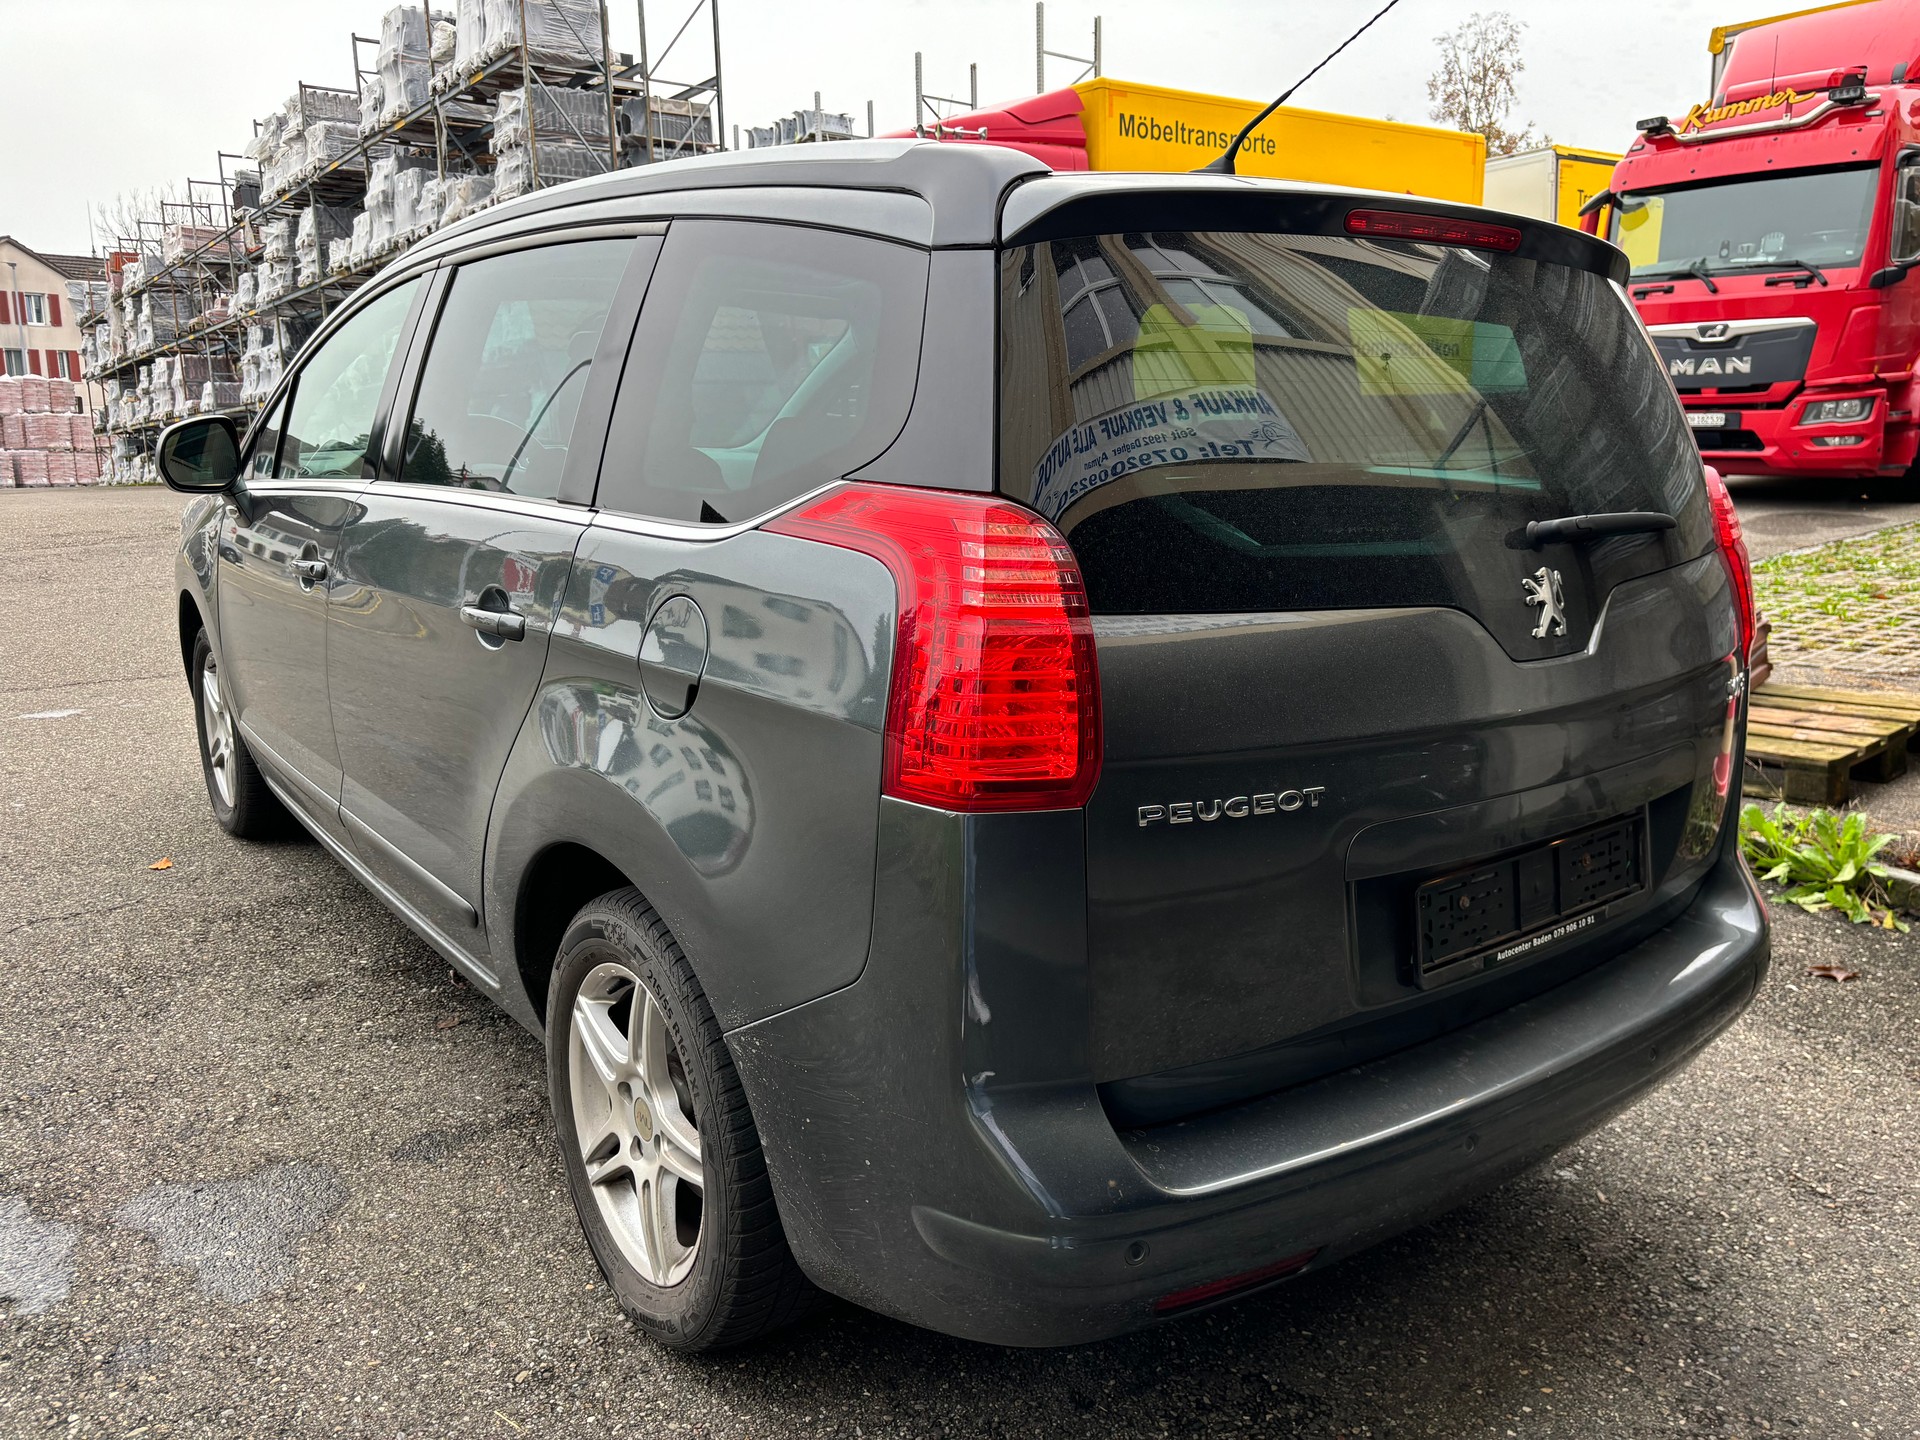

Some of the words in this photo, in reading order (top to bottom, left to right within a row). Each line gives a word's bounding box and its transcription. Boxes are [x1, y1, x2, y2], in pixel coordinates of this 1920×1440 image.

[1679, 88, 1817, 134] Kummer
[1670, 356, 1752, 376] MAN
[1138, 786, 1326, 827] PEUGEOT
[1497, 941, 1532, 961] Autocenter
[1532, 933, 1552, 947] Baden
[1553, 926, 1566, 939] 079
[1578, 918, 1587, 928] 10
[1586, 915, 1595, 924] 91
[646, 969, 674, 1020] 215/55
[672, 1021, 688, 1057] R16
[639, 1312, 678, 1334] Barum
